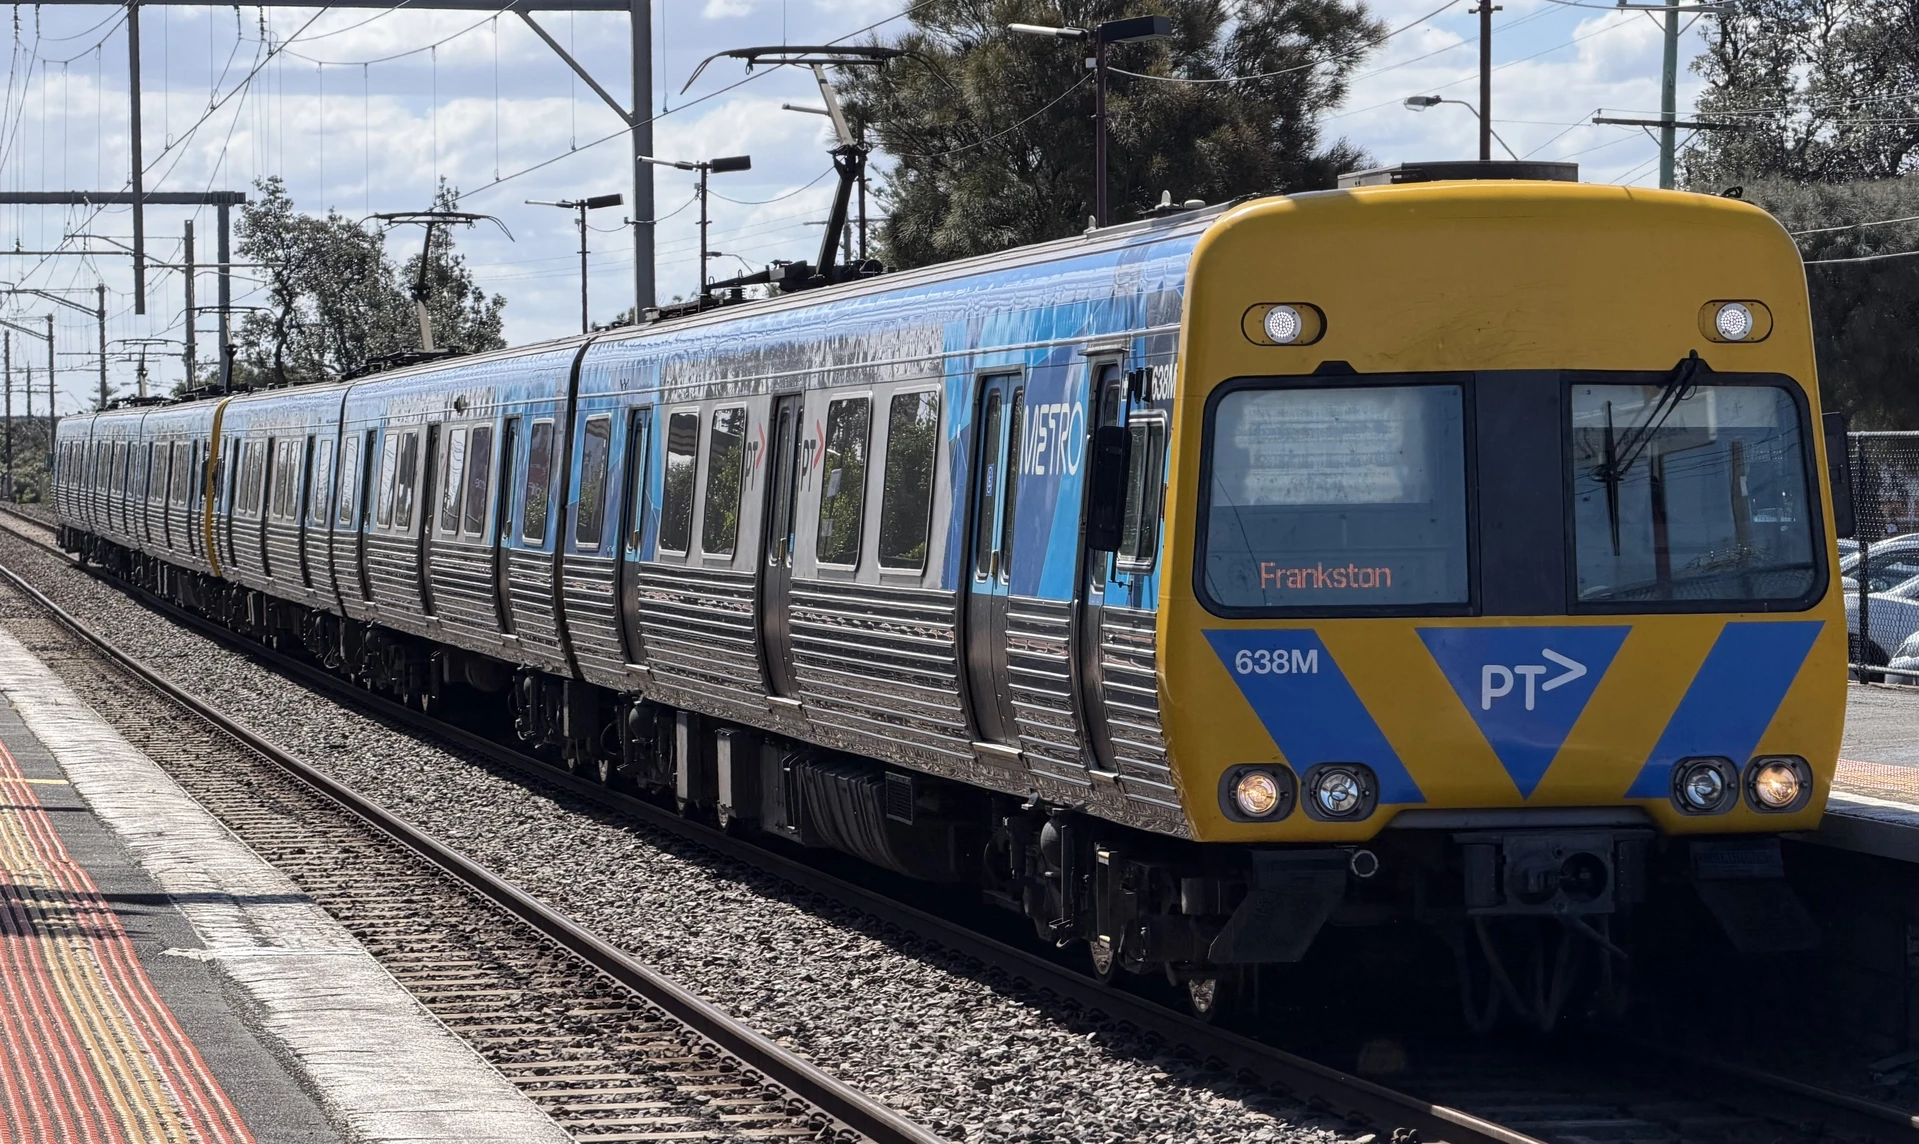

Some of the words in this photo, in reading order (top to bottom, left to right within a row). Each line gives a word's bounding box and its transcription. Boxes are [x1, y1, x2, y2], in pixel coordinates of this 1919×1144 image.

[1152, 364, 1178, 400] 638M
[1022, 402, 1082, 474] METRO
[1260, 561, 1391, 589] Frankston
[1236, 649, 1318, 674] 638M
